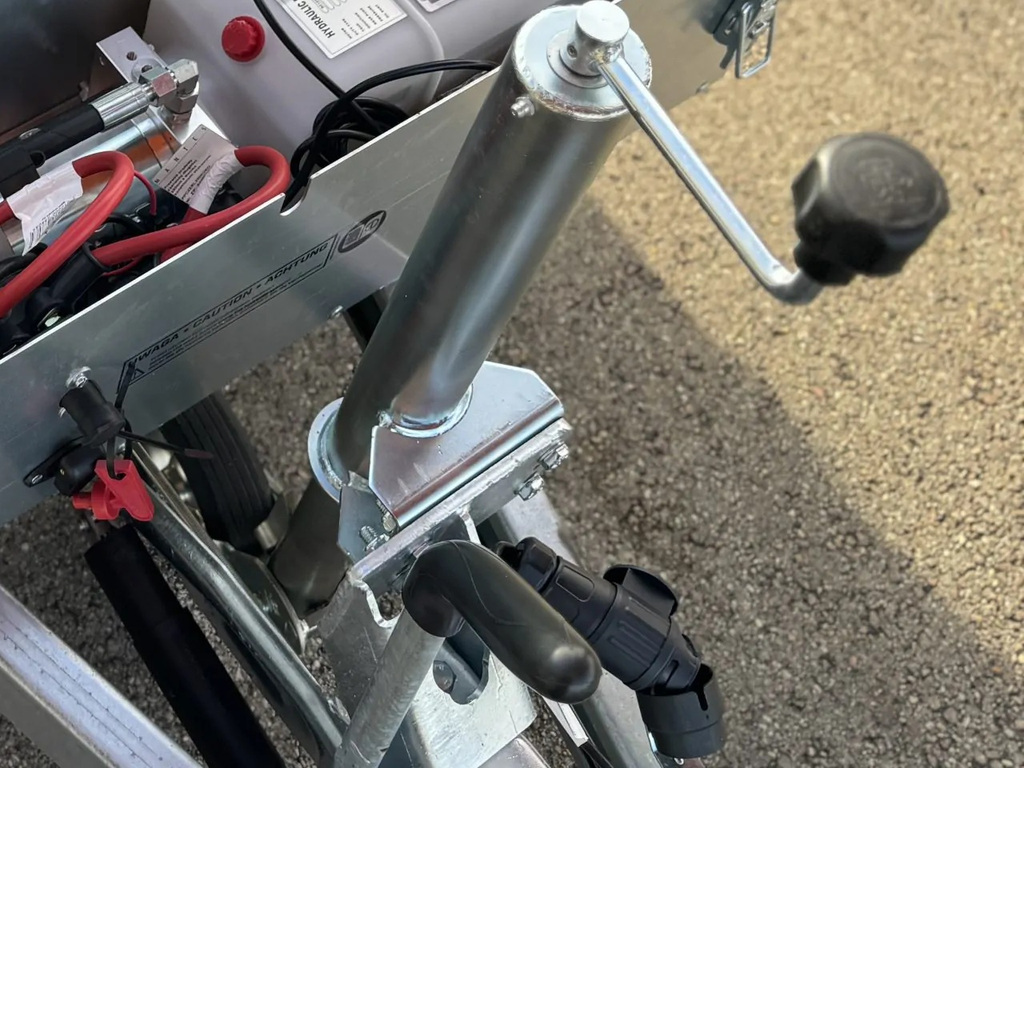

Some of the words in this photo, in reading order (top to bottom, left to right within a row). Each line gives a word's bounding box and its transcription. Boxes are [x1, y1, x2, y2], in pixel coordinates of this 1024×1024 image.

[297, 1, 336, 39] HYDRAULIC
[192, 289, 253, 328] CAUTION
[264, 242, 328, 285] ACHTUNG
